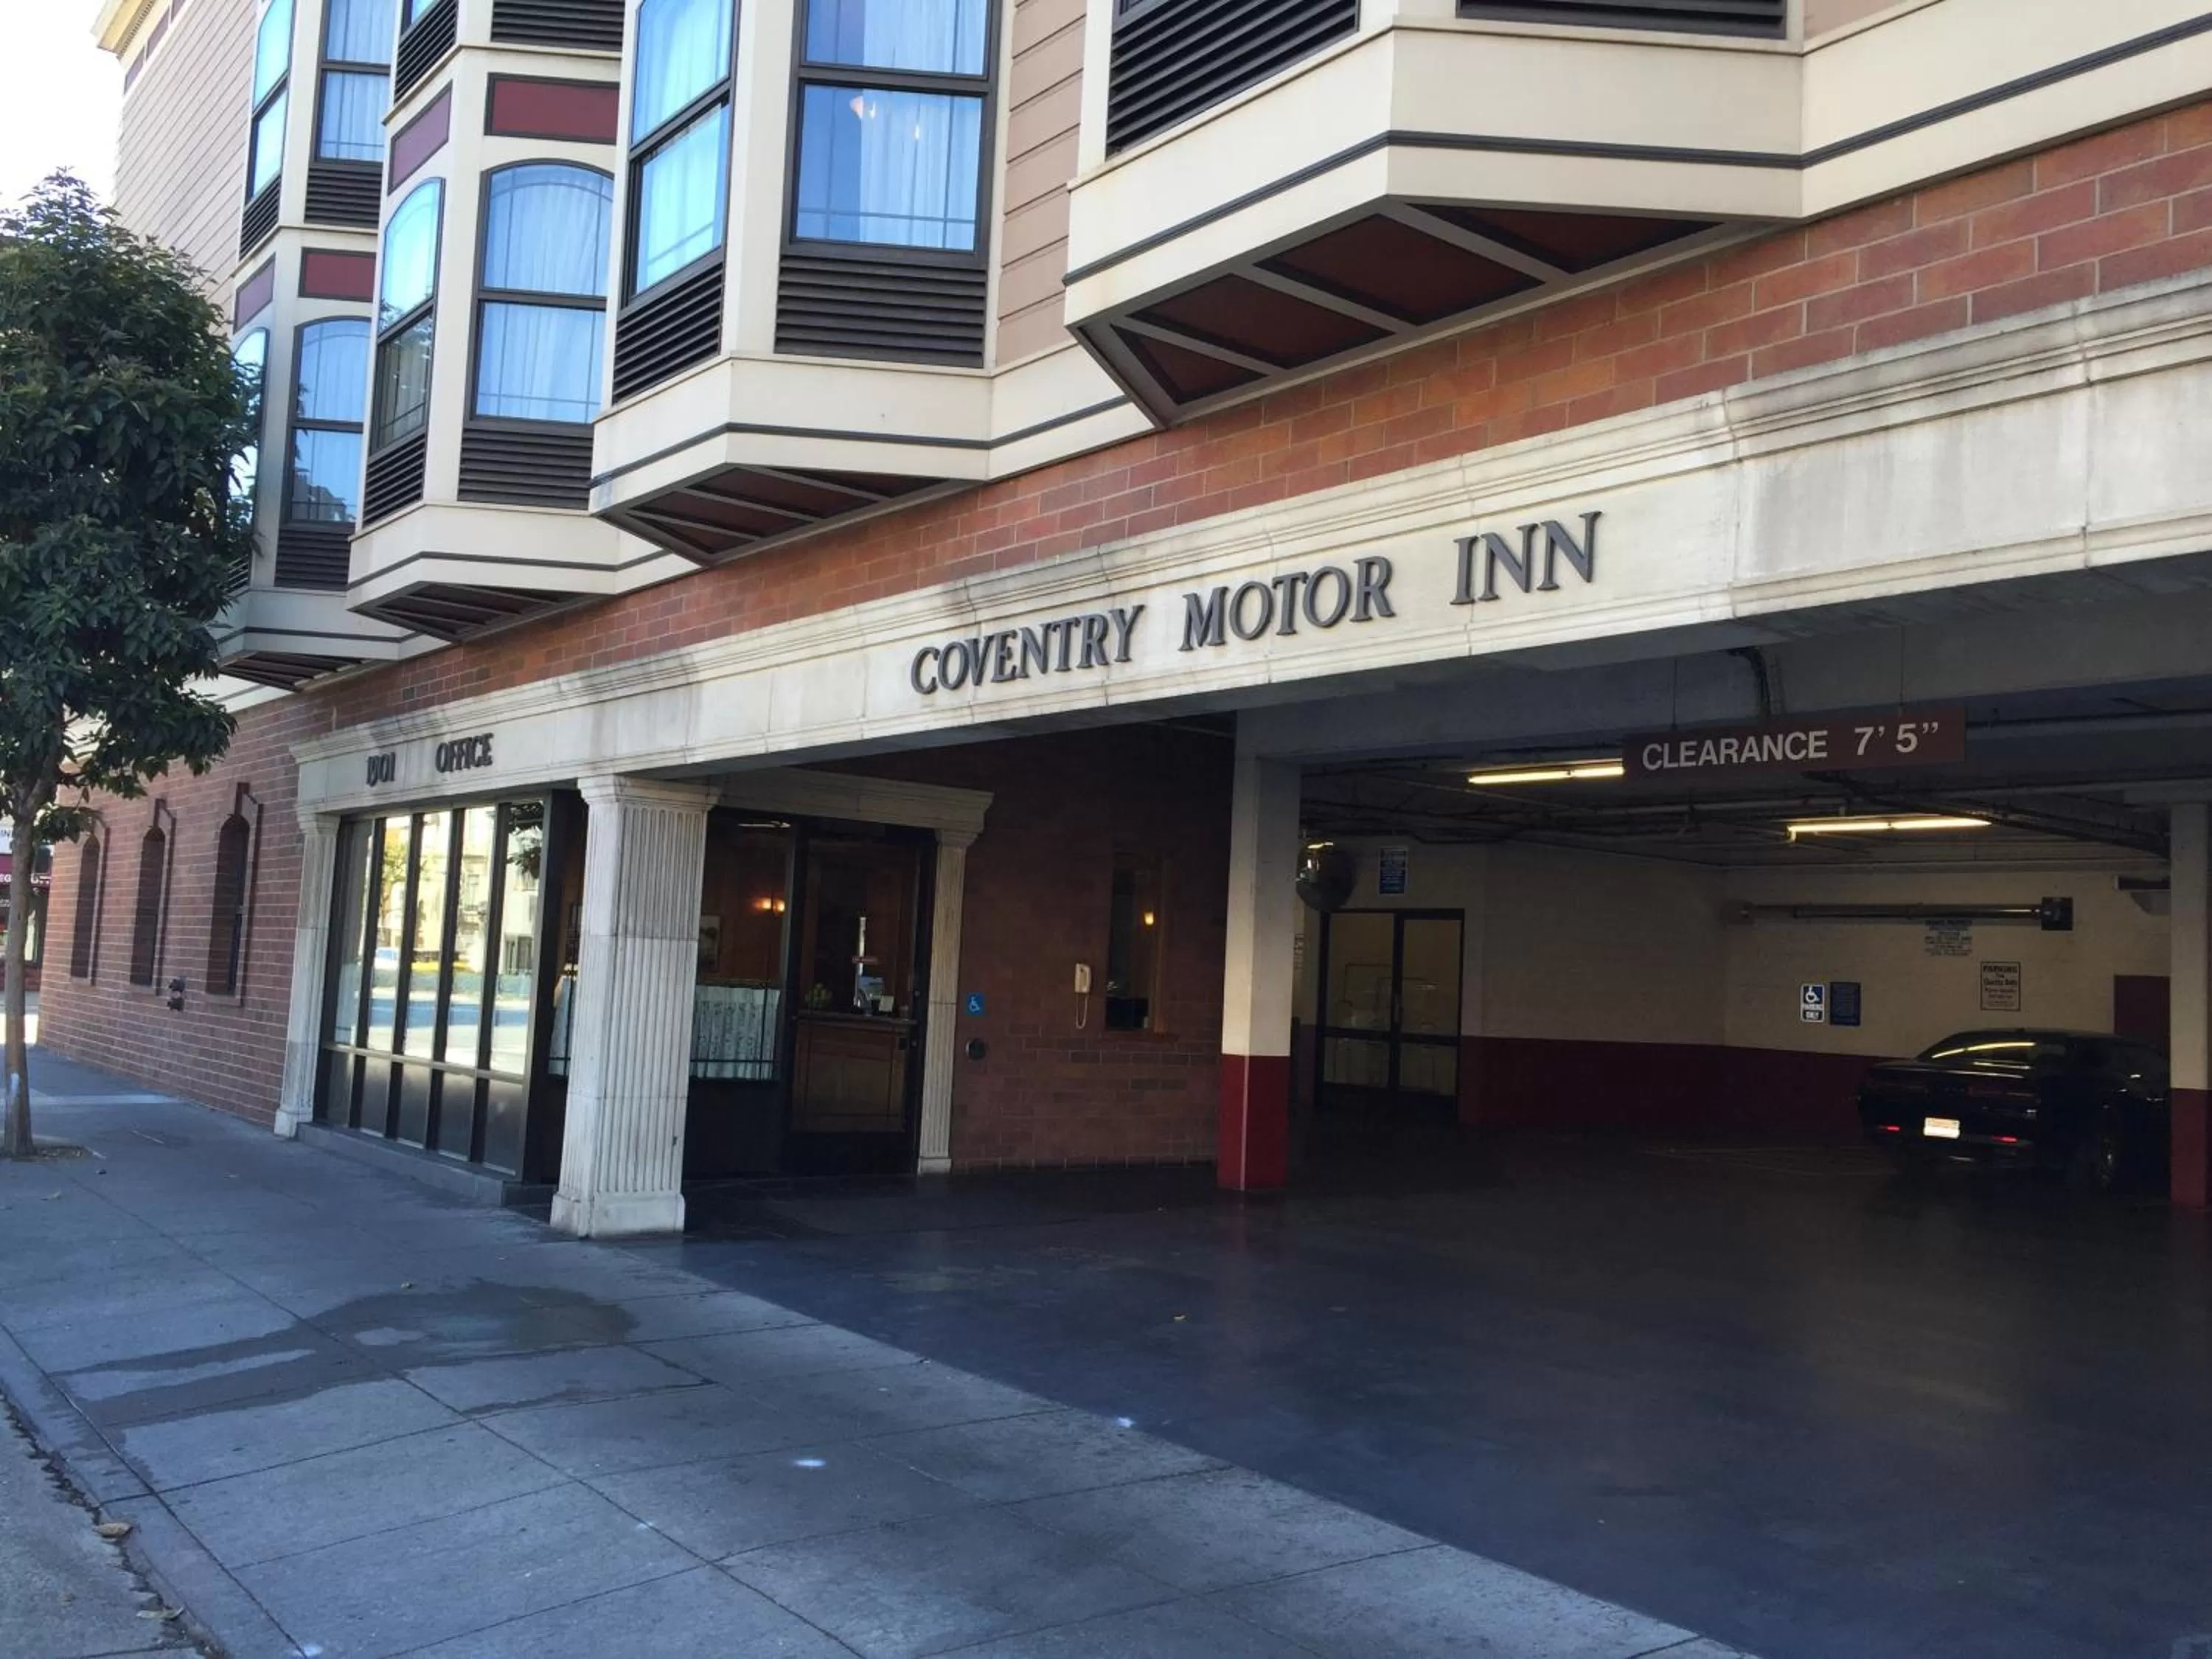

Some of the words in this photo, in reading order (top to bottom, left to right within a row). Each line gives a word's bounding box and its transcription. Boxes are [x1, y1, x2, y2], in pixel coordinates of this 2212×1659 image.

[911, 604, 1147, 695] COVENTRY
[1180, 554, 1396, 652] MOTOR
[1450, 510, 1602, 606] INN
[435, 732, 495, 773] OFFICE
[1642, 729, 1829, 771] CLEARANCE
